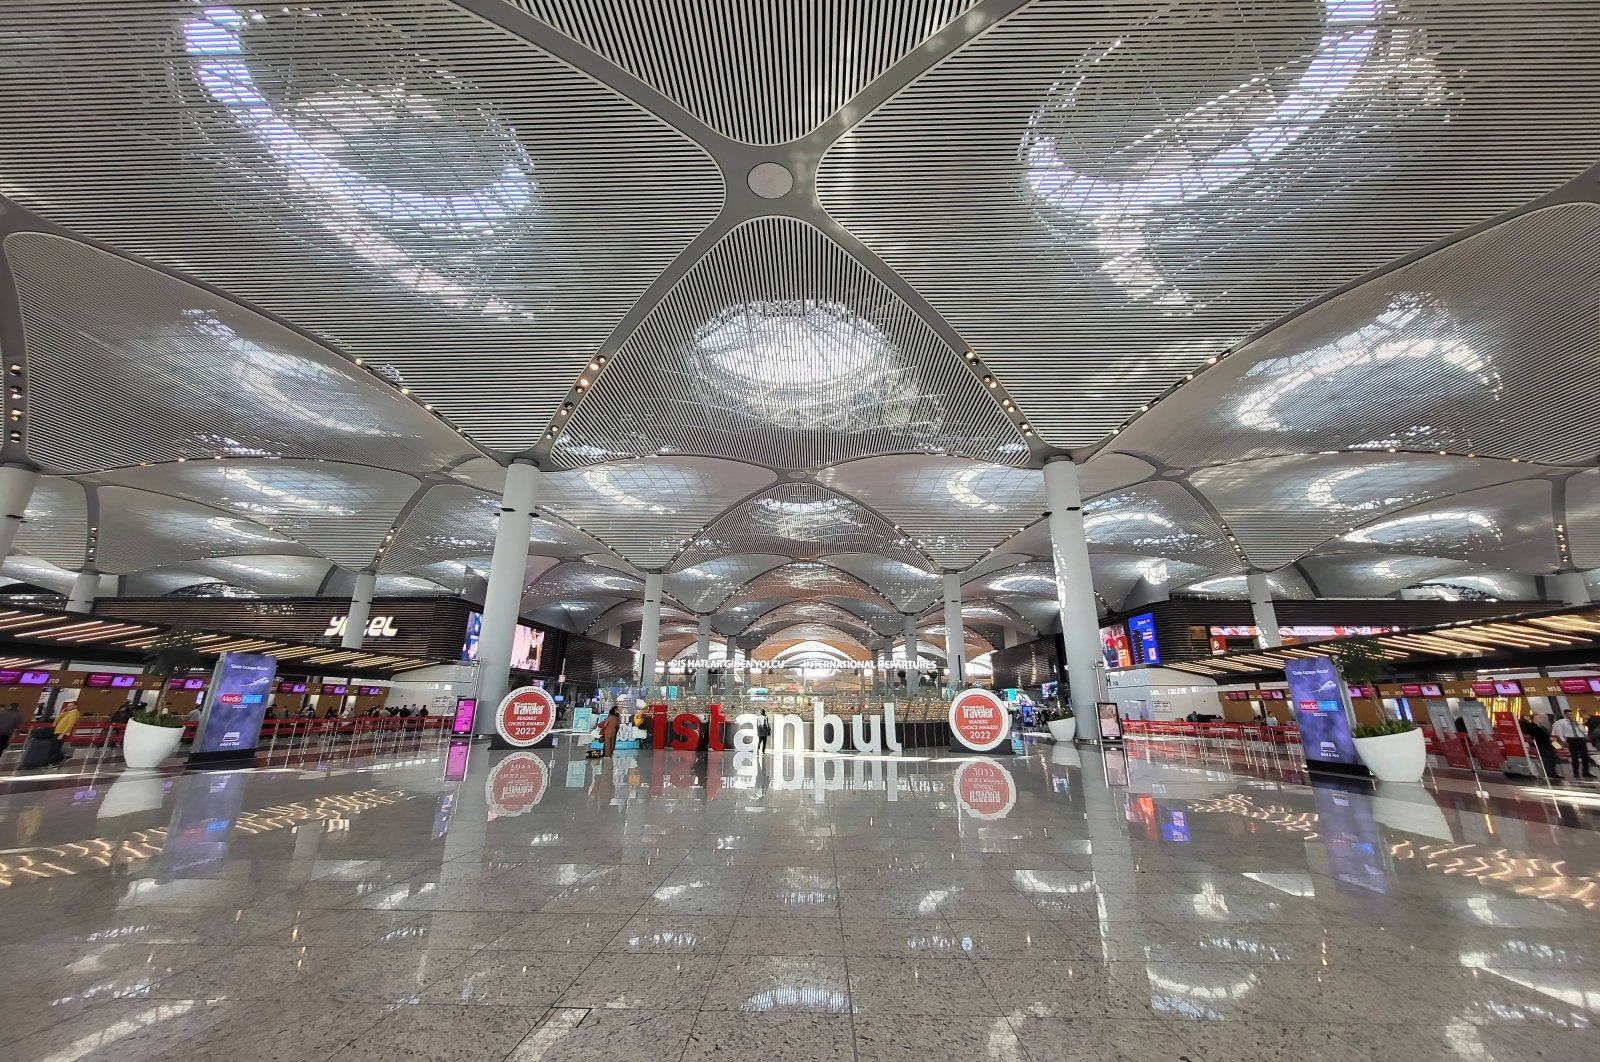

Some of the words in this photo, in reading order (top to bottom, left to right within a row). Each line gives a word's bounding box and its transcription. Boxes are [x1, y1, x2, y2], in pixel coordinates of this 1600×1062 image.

[687, 659, 721, 669] HATLAR
[754, 659, 785, 669] YOLCU
[803, 659, 876, 669] INTERNATIONAL
[877, 659, 937, 669] DEPARTURES
[513, 701, 545, 715] Traveler
[961, 705, 994, 719] Traveler
[515, 727, 536, 735] 2022
[653, 701, 903, 757] istanbul
[969, 731, 991, 739] 2022
